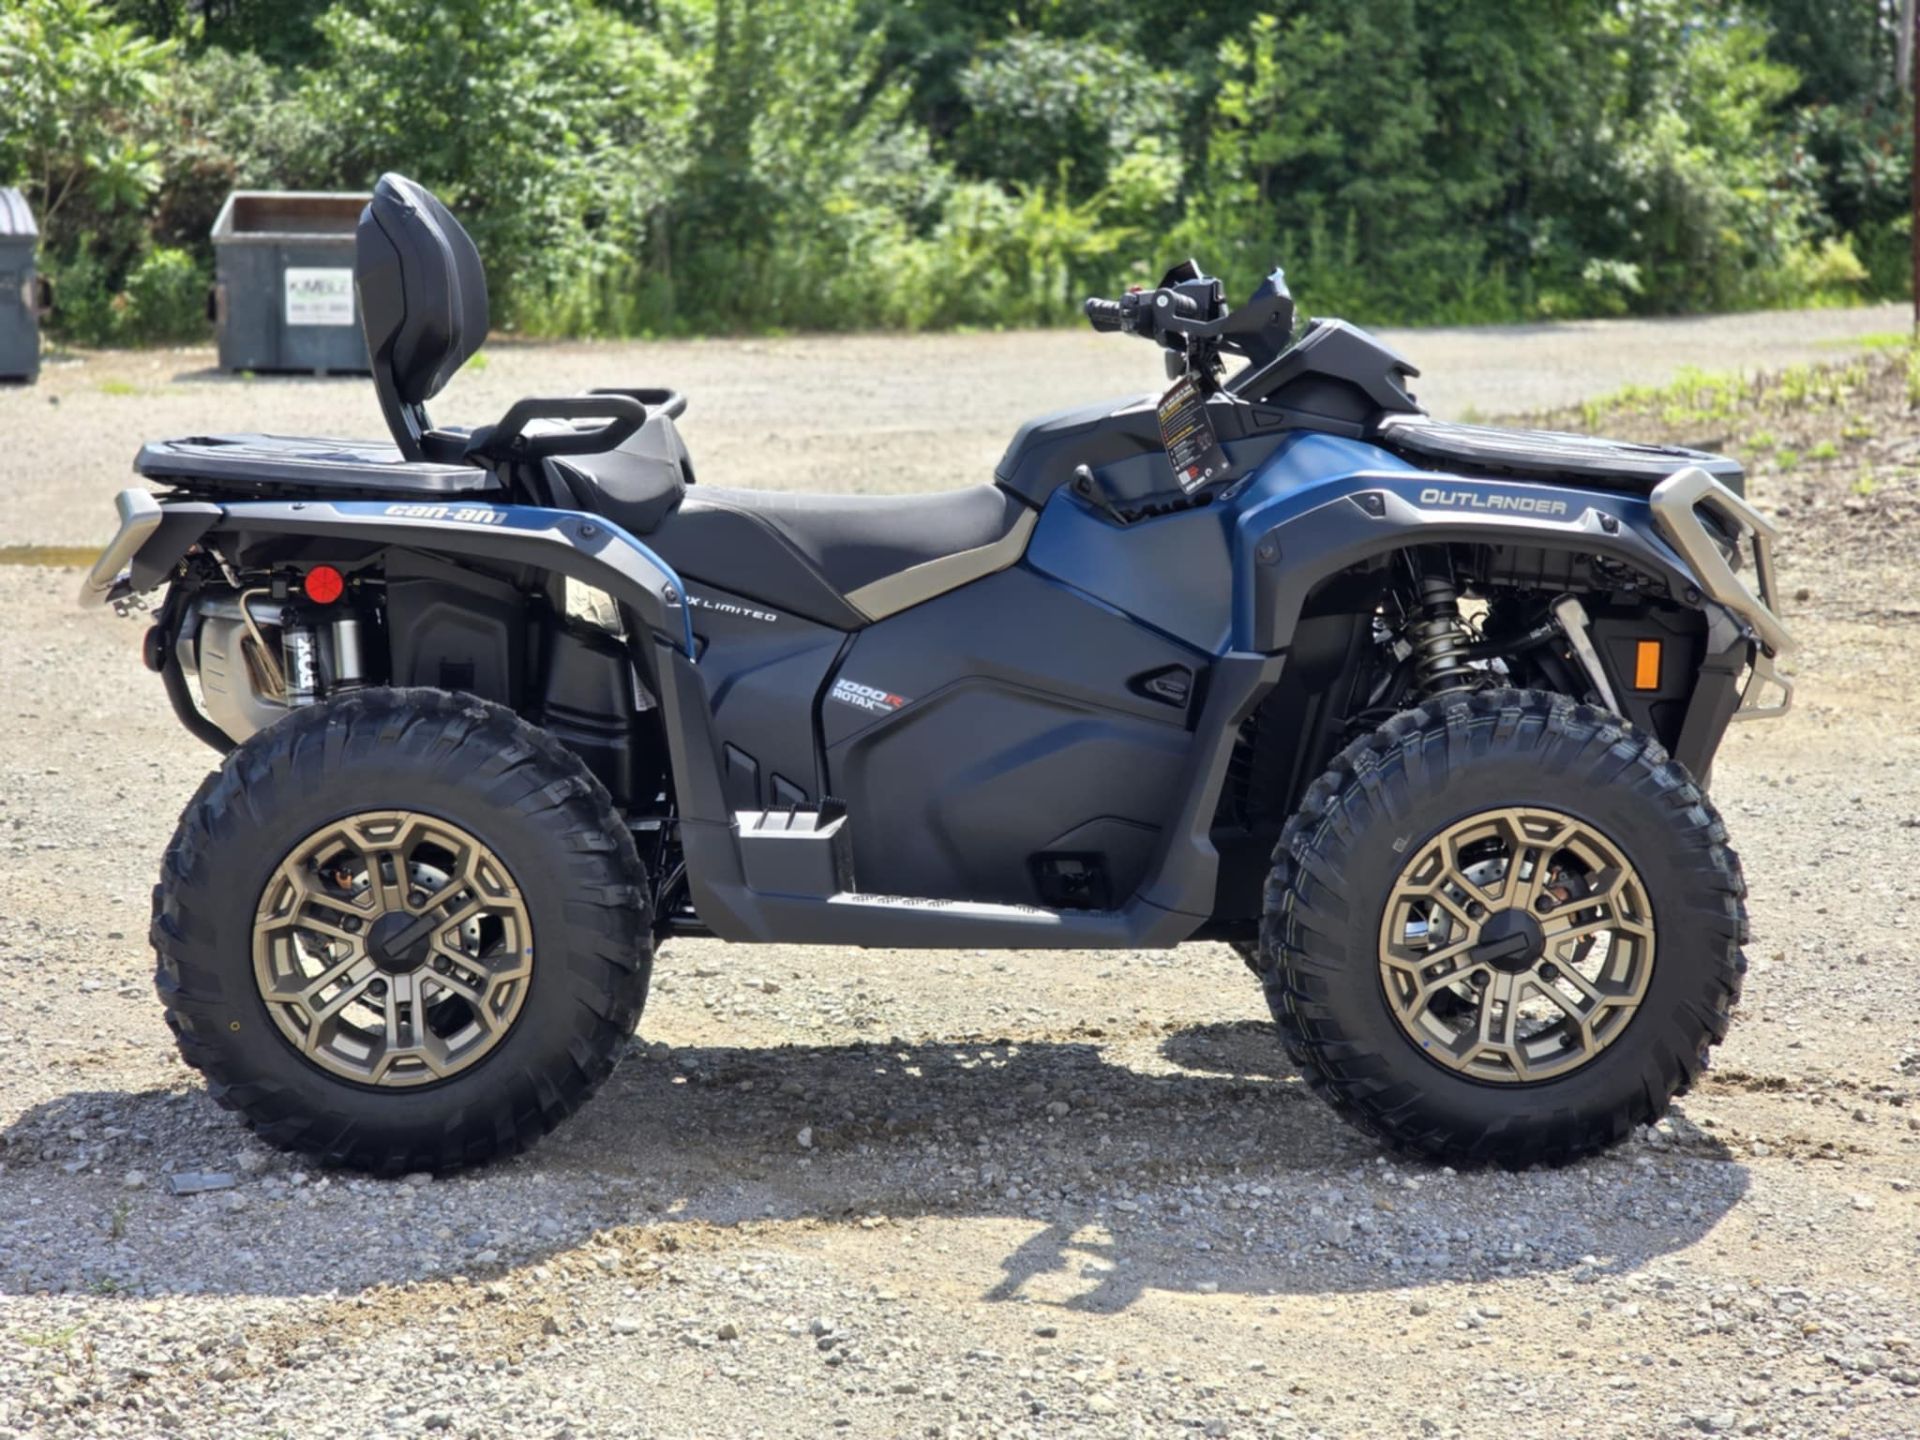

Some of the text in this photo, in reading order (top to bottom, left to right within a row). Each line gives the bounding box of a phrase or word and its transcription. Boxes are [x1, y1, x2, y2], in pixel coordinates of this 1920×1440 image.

[1420, 488, 1567, 515] OUTLANDER
[703, 600, 777, 622] LIMITED
[832, 688, 874, 710] ROTAX
[836, 679, 903, 709] 1000R
